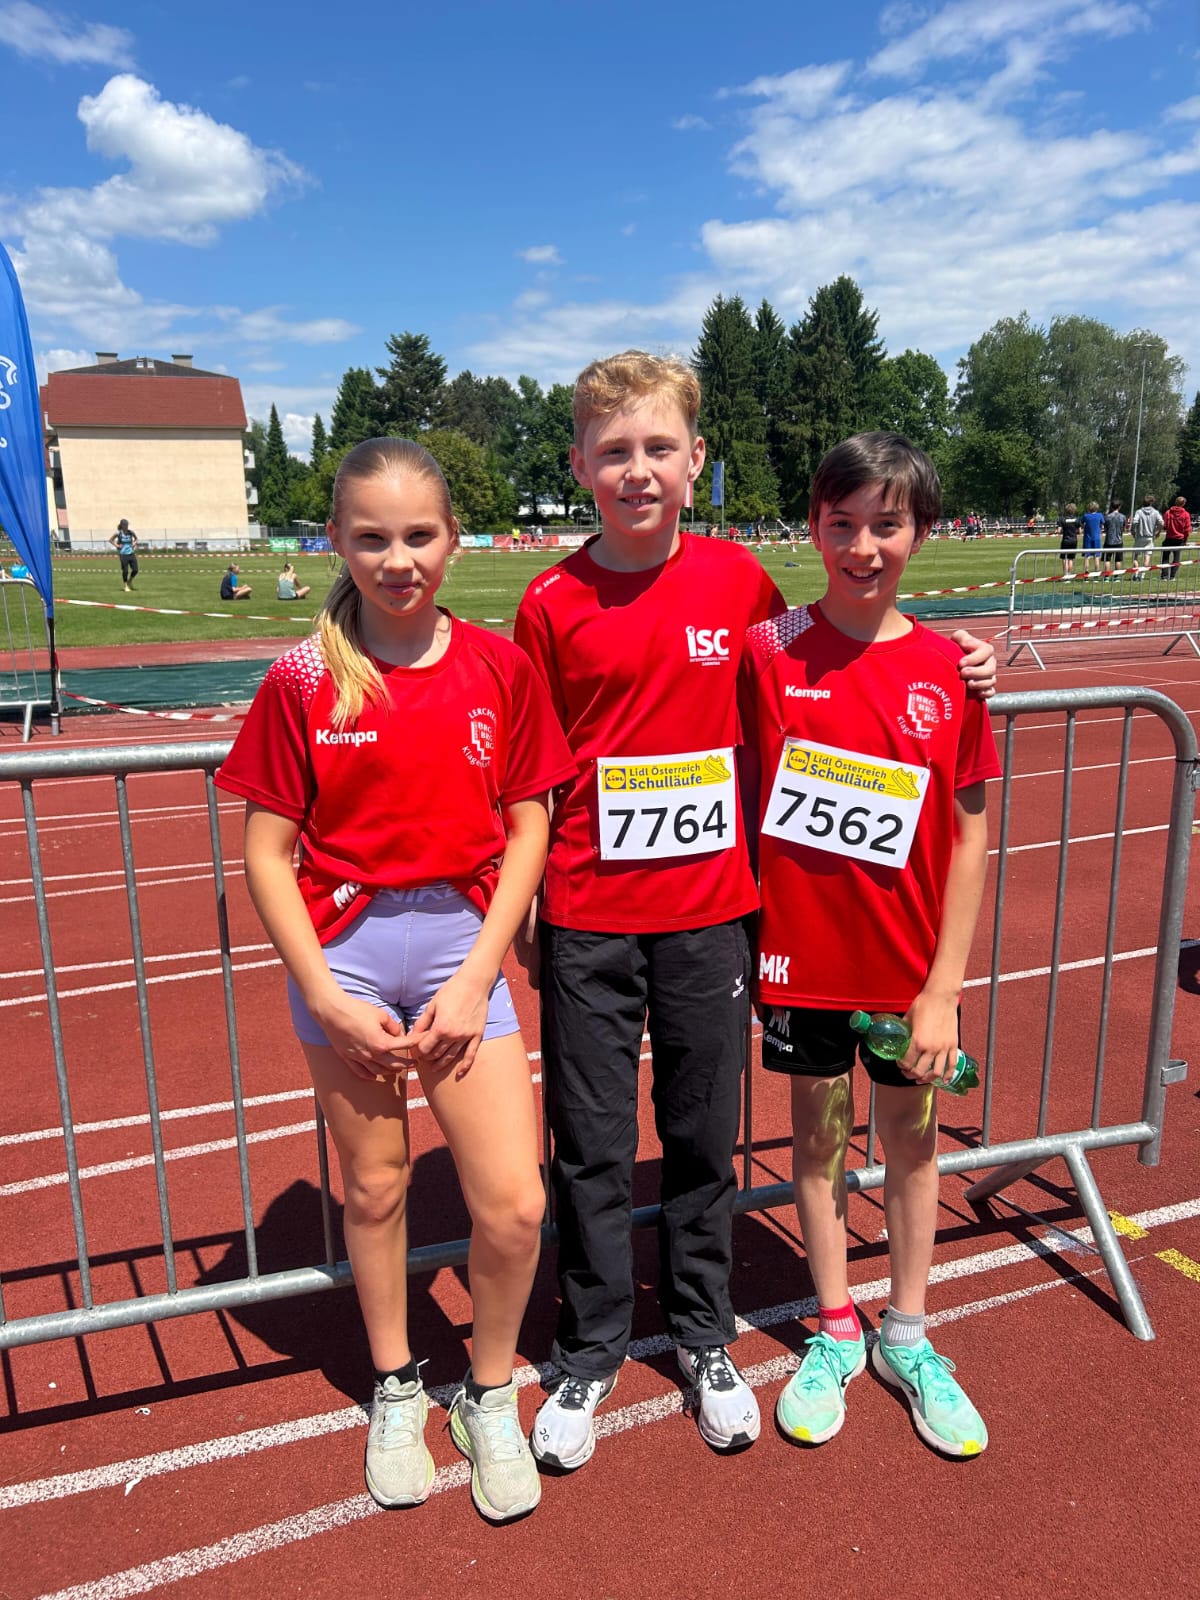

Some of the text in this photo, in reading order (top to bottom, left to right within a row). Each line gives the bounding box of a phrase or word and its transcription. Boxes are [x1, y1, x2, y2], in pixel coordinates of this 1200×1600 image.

[785, 685, 831, 701] Kempa
[907, 681, 953, 720] LERCHENFELD
[315, 729, 378, 747] Kempa
[629, 763, 701, 777] Lidl Österreich
[809, 763, 886, 792] Schulläufe
[813, 754, 887, 779] Lidl Österreich
[629, 773, 703, 790] Schulläufe
[607, 800, 728, 849] 7764
[775, 787, 905, 855] 7562
[759, 952, 791, 985] MK
